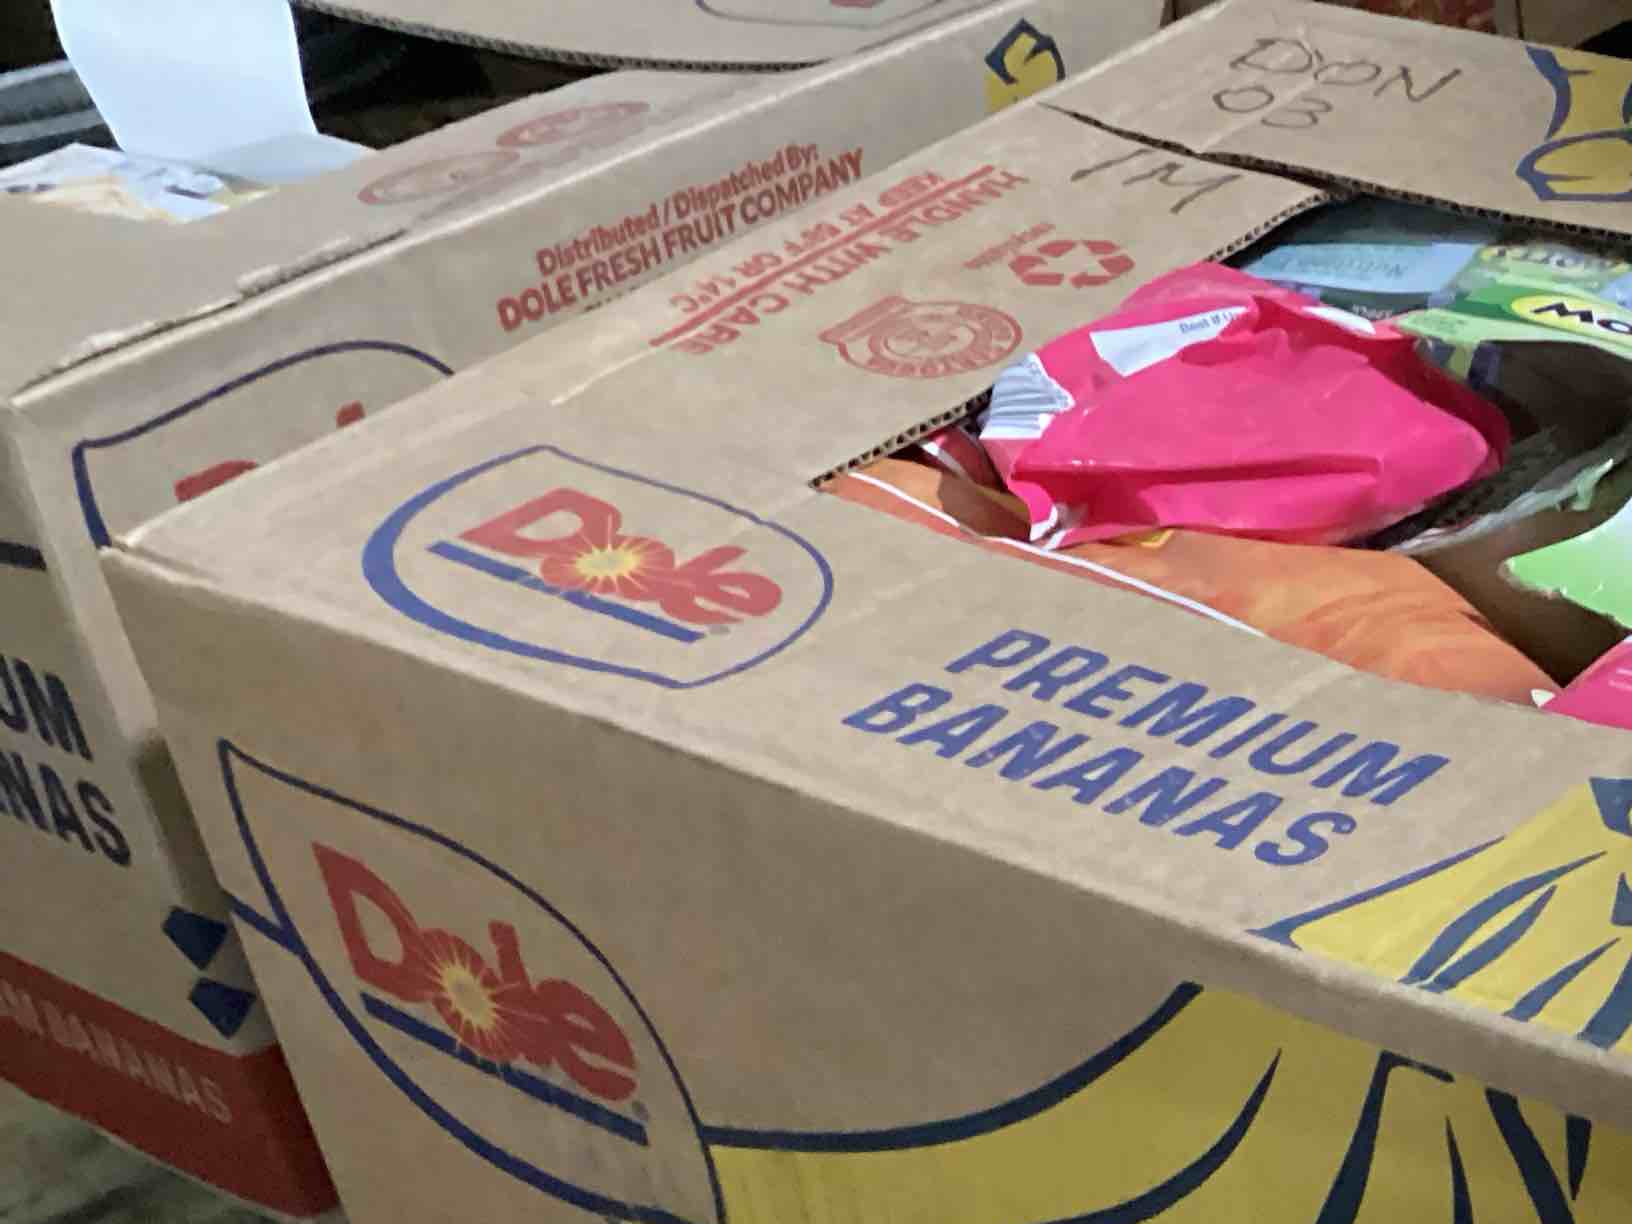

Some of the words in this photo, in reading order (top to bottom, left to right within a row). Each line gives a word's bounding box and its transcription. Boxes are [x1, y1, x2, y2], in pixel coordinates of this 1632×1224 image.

[497, 275, 576, 332] DOLE
[576, 243, 663, 297] FRESH
[663, 210, 738, 260] FRUIT
[739, 148, 864, 224] COMPANY
[535, 203, 661, 276] Distributed
[673, 153, 786, 219] Dispatched
[458, 488, 784, 626] Dole
[841, 682, 1358, 867] BANANAS
[945, 628, 1451, 806] PREMIUM
[311, 840, 639, 1104] Dole
